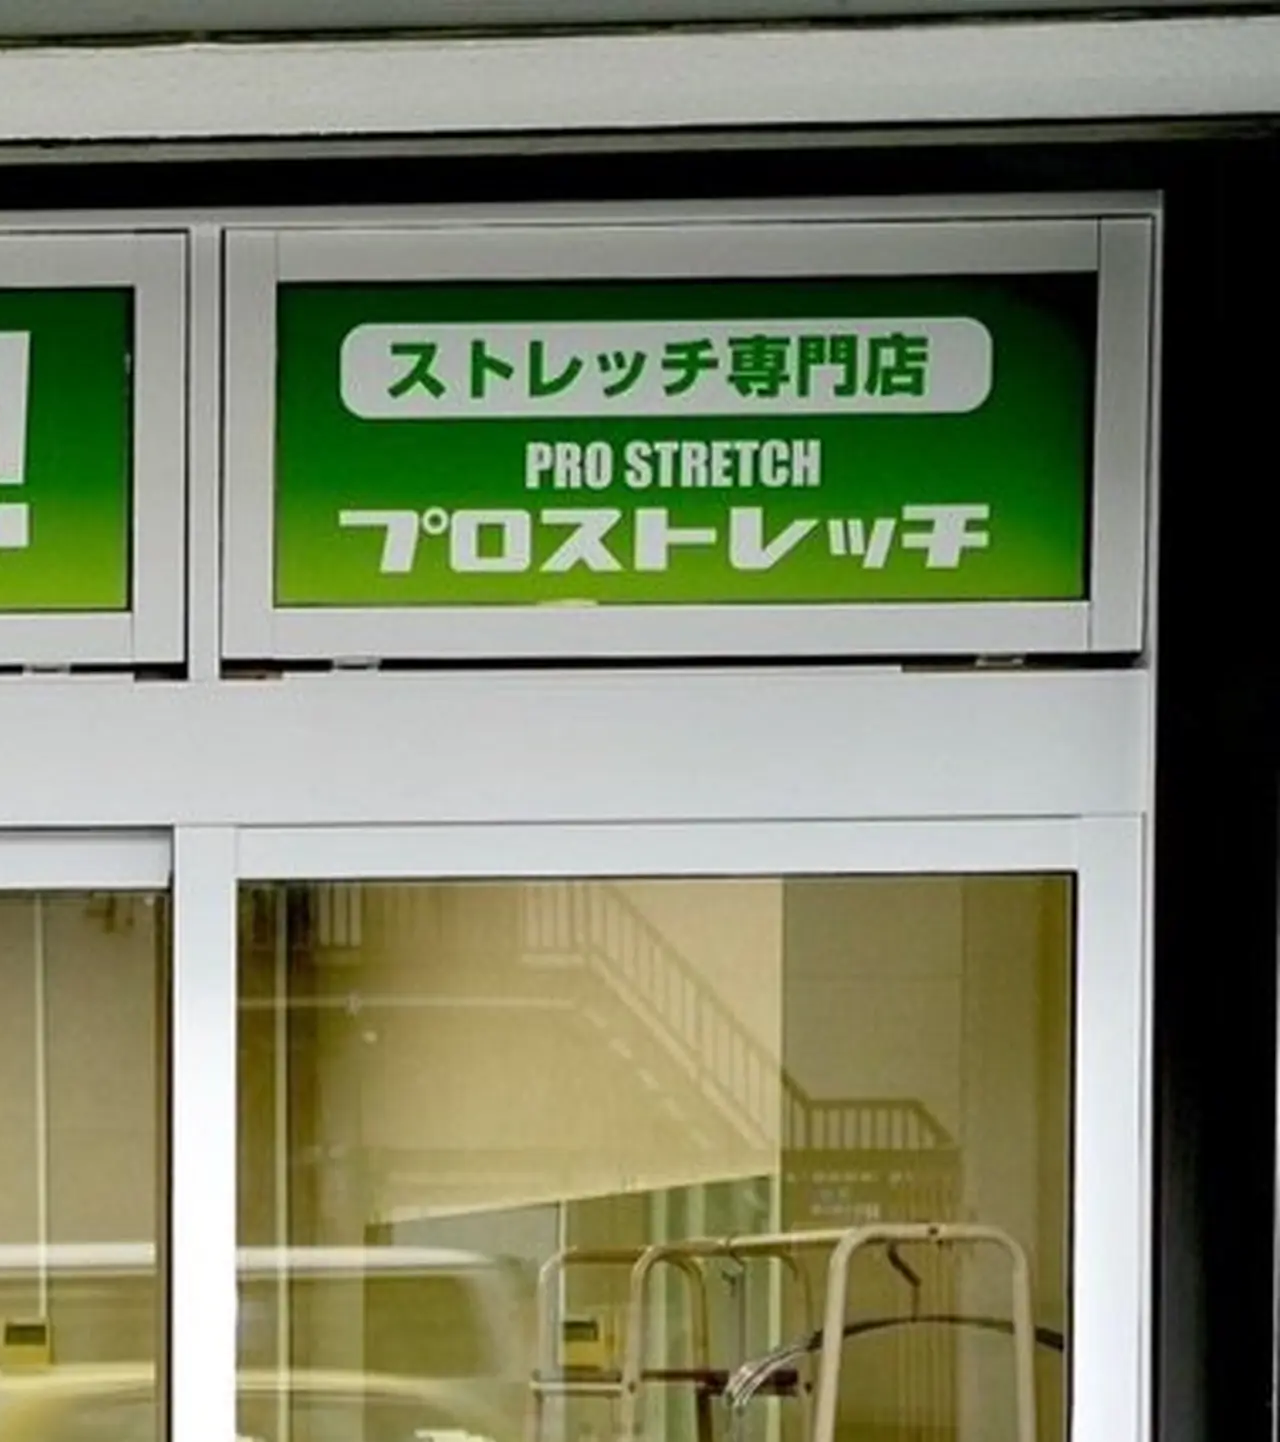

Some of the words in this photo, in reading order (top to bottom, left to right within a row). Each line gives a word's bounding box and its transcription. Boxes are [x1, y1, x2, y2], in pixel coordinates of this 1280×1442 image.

[387, 333, 929, 399] ストレッチ専門店
[525, 441, 609, 490] PRO
[625, 439, 821, 488] STRETCH
[338, 504, 990, 574] プロストレッチ
